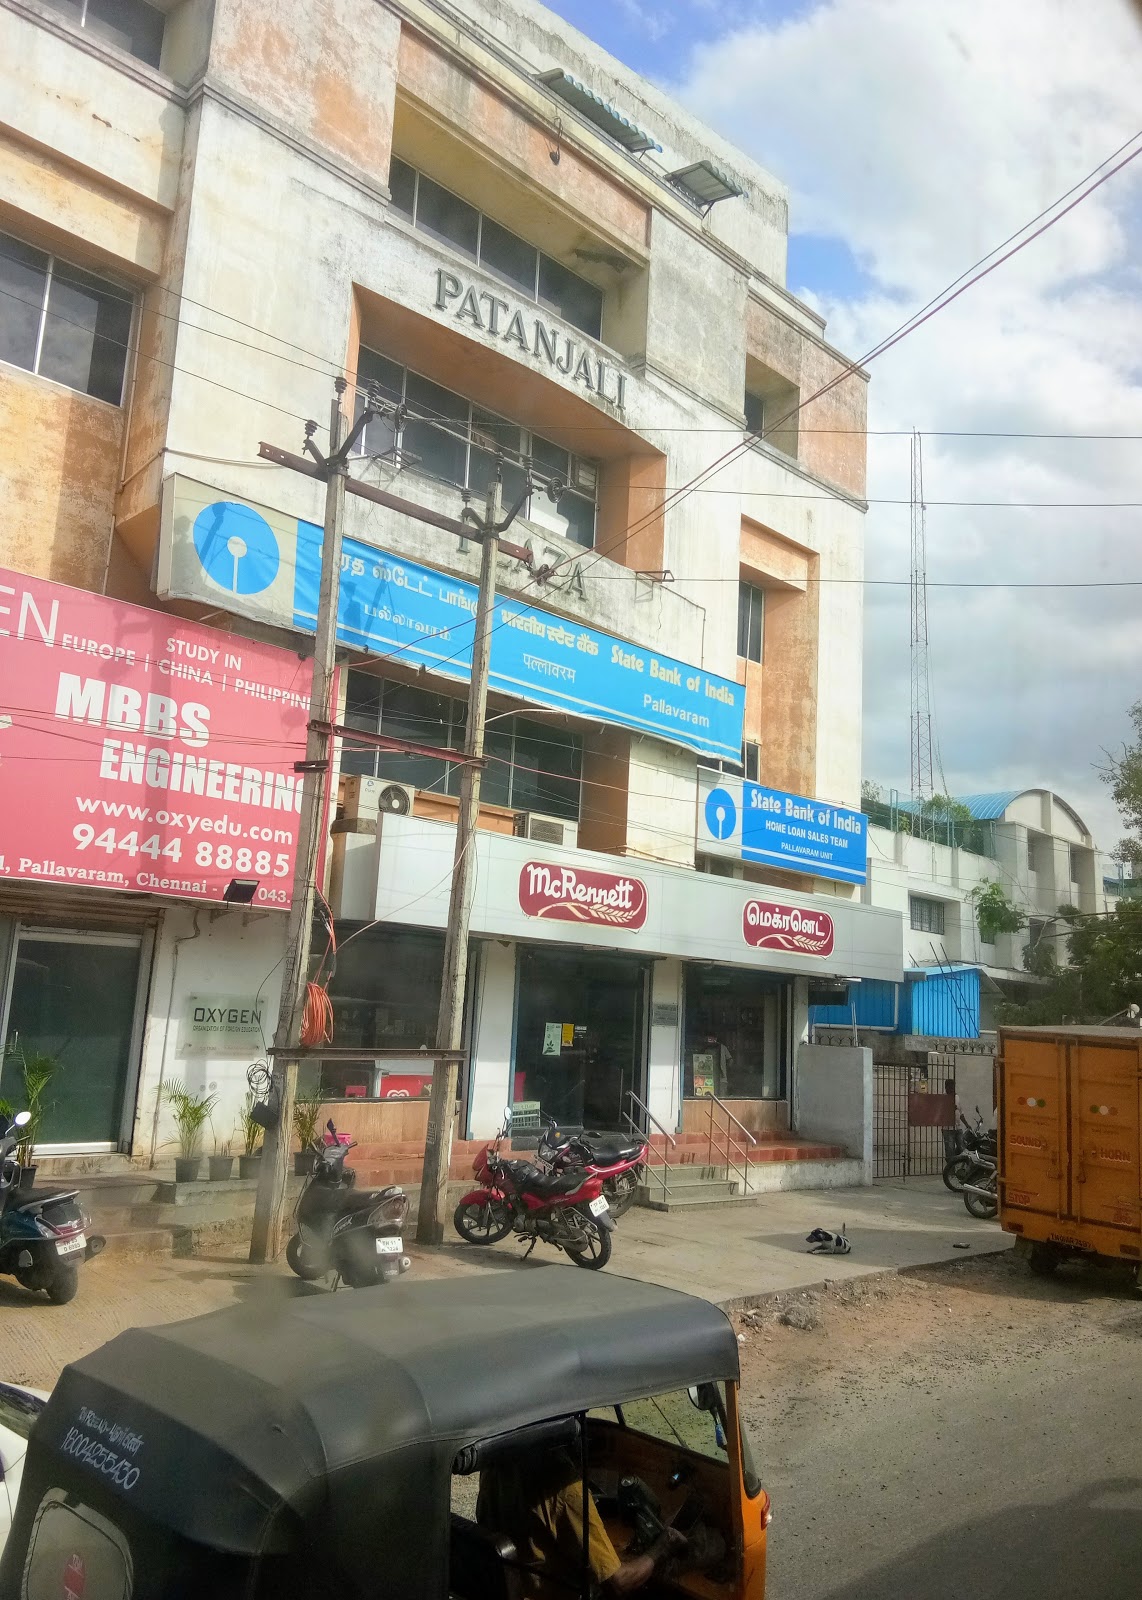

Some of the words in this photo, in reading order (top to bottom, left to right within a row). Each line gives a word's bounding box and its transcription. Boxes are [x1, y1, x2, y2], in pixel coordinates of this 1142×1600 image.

[434, 267, 628, 410] PATANJALI
[373, 558, 432, 597] ஸ்டேட்
[456, 515, 588, 601] AZA
[364, 603, 451, 641] பல்லாவரம்
[501, 609, 545, 638] भारतीय
[547, 625, 575, 648] स्टेट
[576, 633, 599, 655] बैंक
[62, 633, 136, 666] EUROPE
[159, 659, 213, 686] CHINA
[166, 637, 222, 664] STUDY
[225, 654, 242, 671] IN
[522, 652, 576, 683] पल्लावरम
[611, 645, 644, 673] State
[650, 658, 681, 687] Bank
[686, 676, 700, 693] of
[705, 678, 734, 706] India
[55, 671, 211, 748] MBBS
[643, 694, 709, 728] Pallavaram
[76, 796, 293, 845] www.oxyedu.com
[751, 789, 781, 814] State
[785, 799, 815, 822] Bank
[818, 811, 830, 826] of
[834, 812, 861, 834] India
[765, 820, 786, 834] HOME
[788, 825, 806, 839] LOAN
[807, 830, 829, 844] SALES
[830, 836, 848, 848] TEAM
[73, 823, 182, 863] 94444
[195, 841, 290, 877] 88885
[781, 842, 819, 858] PALLAVARAM
[820, 851, 833, 860] UNIT
[18, 858, 130, 887] Pallavaram,
[136, 872, 207, 894] Chennai
[527, 864, 634, 909] McRennett
[193, 1007, 262, 1024] OXYGEN
